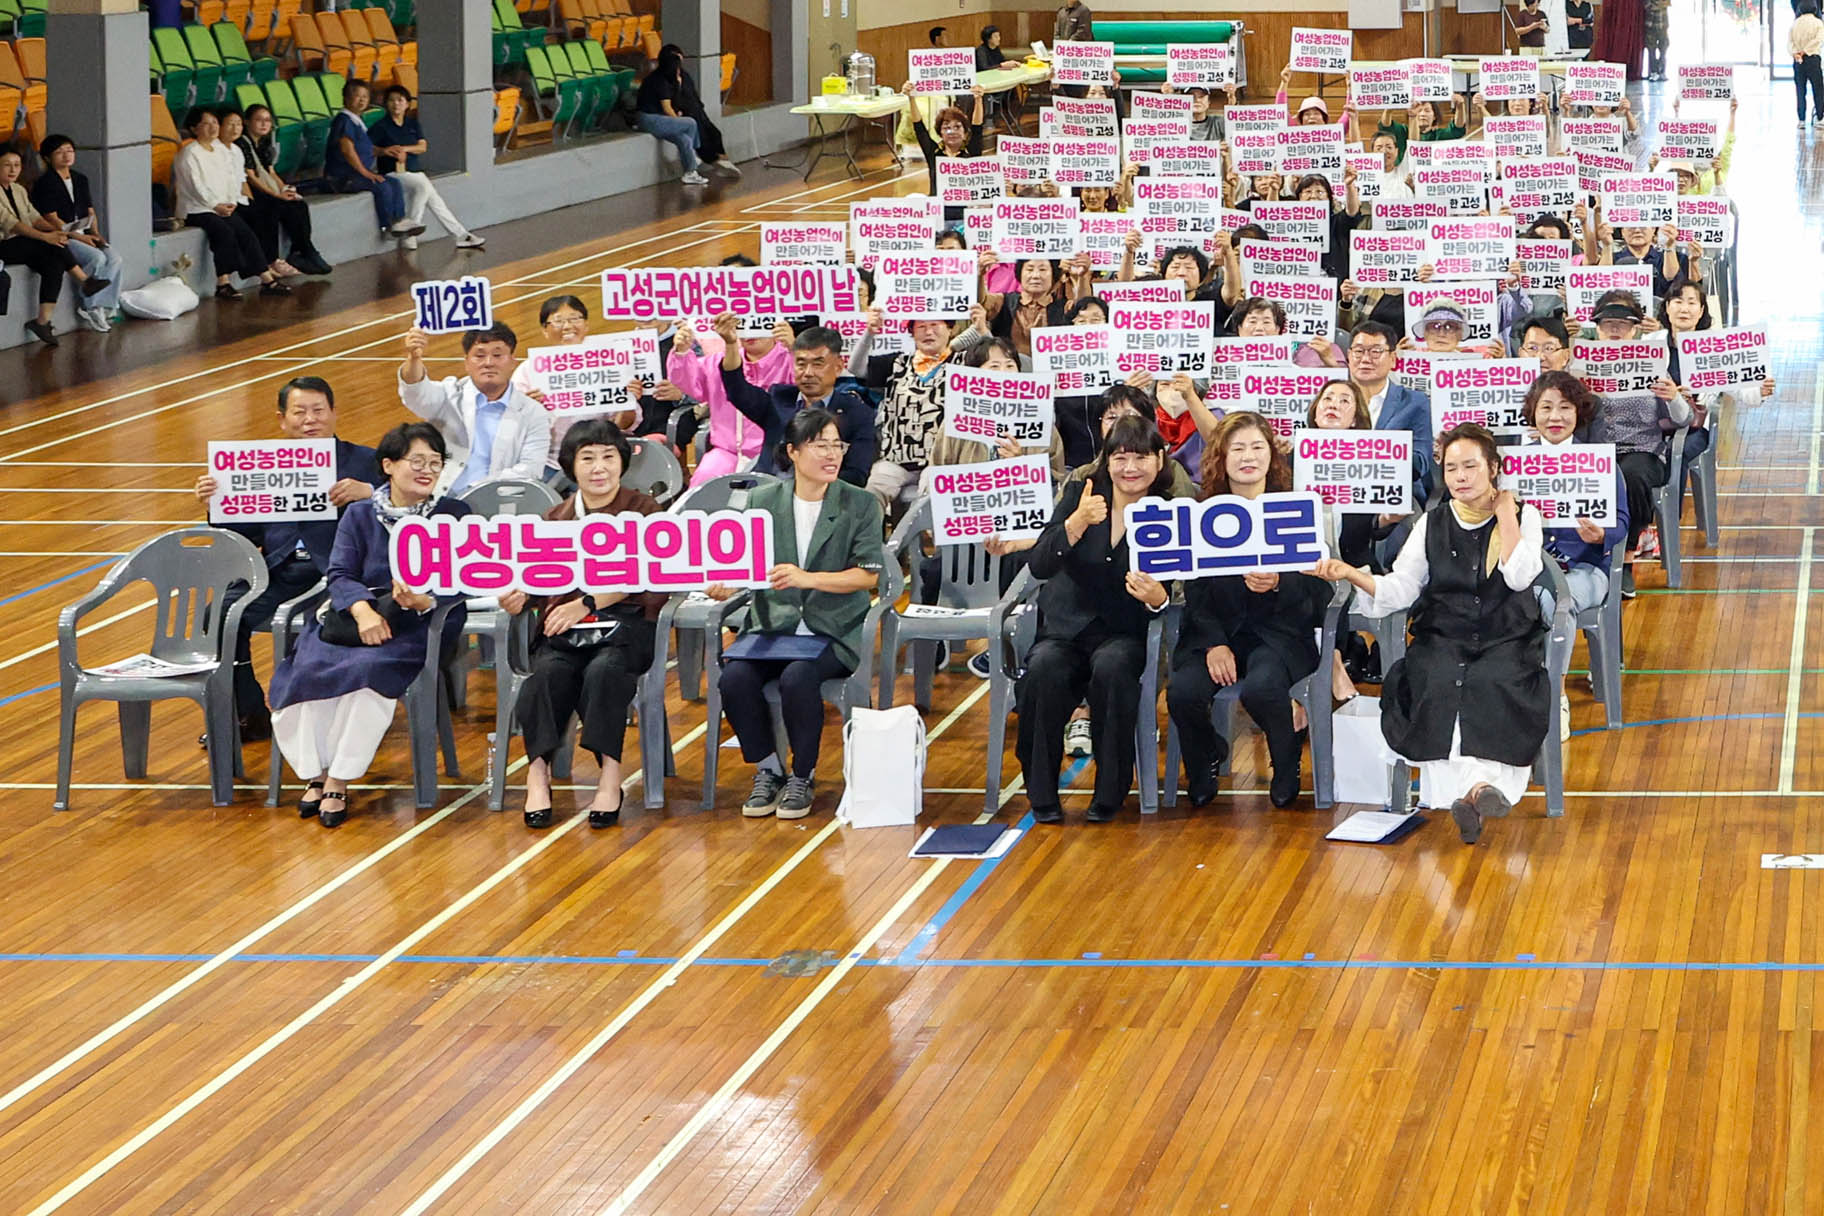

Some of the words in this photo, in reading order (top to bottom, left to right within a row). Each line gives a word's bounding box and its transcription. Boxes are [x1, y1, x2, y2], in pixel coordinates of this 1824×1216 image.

[1293, 32, 1349, 46] 여성농업인이
[1054, 45, 1111, 58] 여성농업인이
[1301, 45, 1342, 55] 만들어가는
[910, 52, 972, 66] 여성농업인이
[1062, 58, 1104, 67] 만들어가는
[1294, 55, 1327, 67] 성평등한
[1327, 57, 1346, 69] 고성
[920, 66, 966, 78] 만들어가는
[1056, 68, 1089, 80] 성평등한
[1090, 69, 1108, 81] 고성
[914, 79, 950, 92] 성평등한
[952, 77, 971, 90] 고성
[1657, 121, 1716, 134] 여성농업인이
[1277, 129, 1341, 144] 여성농업인이
[1666, 135, 1710, 145] 만들어가는
[1287, 143, 1335, 156] 만들어가는
[1659, 146, 1694, 158] 성평등한
[1695, 147, 1714, 159] 고성
[1281, 157, 1319, 171] 성평등한
[1320, 155, 1340, 168] 고성
[1504, 161, 1575, 179] 여성농업인이
[1137, 182, 1218, 199] 여성농업인이
[1515, 178, 1568, 192] 만들어가는
[1603, 177, 1674, 192] 여성농업인이
[1149, 201, 1209, 214] 만들어가는
[1508, 193, 1550, 208] 성평등한
[1552, 191, 1574, 205] 고성
[1614, 193, 1667, 206] 만들어가는
[1606, 208, 1649, 222] 성평등한
[1650, 207, 1672, 221] 고성
[1140, 216, 1188, 232] 성평등한
[1189, 217, 1215, 232] 고성
[764, 227, 842, 243] 여성농업인이
[775, 244, 834, 257] 만들어가는
[882, 256, 972, 275] 여성농업인이
[832, 269, 855, 311] 날
[895, 277, 963, 292] 만들어가는
[416, 276, 487, 331] 제2회
[885, 295, 938, 313] 성평등한
[940, 295, 969, 313] 고성
[1113, 309, 1210, 330] 여성농업인이
[1127, 332, 1199, 349] 만들어가는
[1681, 331, 1766, 355] 여성농업인이
[533, 348, 629, 373] 여성농업인이
[1572, 344, 1663, 361] 여성농업인이
[1695, 350, 1758, 370] 만들어가는
[1115, 352, 1173, 372] 성평등한
[1175, 352, 1206, 372] 고성
[1586, 361, 1653, 375] 만들어가는
[549, 369, 620, 390] 만들어가는
[1435, 365, 1536, 388] 여성농업인이
[1631, 375, 1659, 390] 고성
[1688, 369, 1738, 389] 성평등한
[1740, 364, 1766, 382] 고성
[949, 374, 1050, 402] 여성농업인이
[540, 390, 596, 411] 성평등한
[599, 385, 628, 405] 고성
[1450, 388, 1526, 407] 만들어가는
[963, 397, 1037, 418] 만들어가는
[952, 414, 1009, 436] 성평등한
[1011, 421, 1043, 441] 고성
[1298, 438, 1407, 460] 여성농업인이
[213, 447, 330, 470] 여성농업인이
[1502, 452, 1611, 475] 여성농업인이
[934, 465, 1046, 495] 여성농업인이
[1314, 463, 1395, 480] 만들어가는
[231, 471, 318, 491] 만들어가는
[1518, 477, 1599, 495] 만들어가는
[219, 493, 288, 515] 성평등한
[291, 492, 327, 512] 고성
[952, 489, 1035, 513] 만들어가는
[1368, 485, 1403, 505] 고성
[1573, 498, 1607, 519] 고성
[943, 514, 1008, 537] 성평등한
[1011, 508, 1045, 530] 고성
[1133, 500, 1320, 573] 힘으로
[398, 517, 766, 588] 여성농업인의
